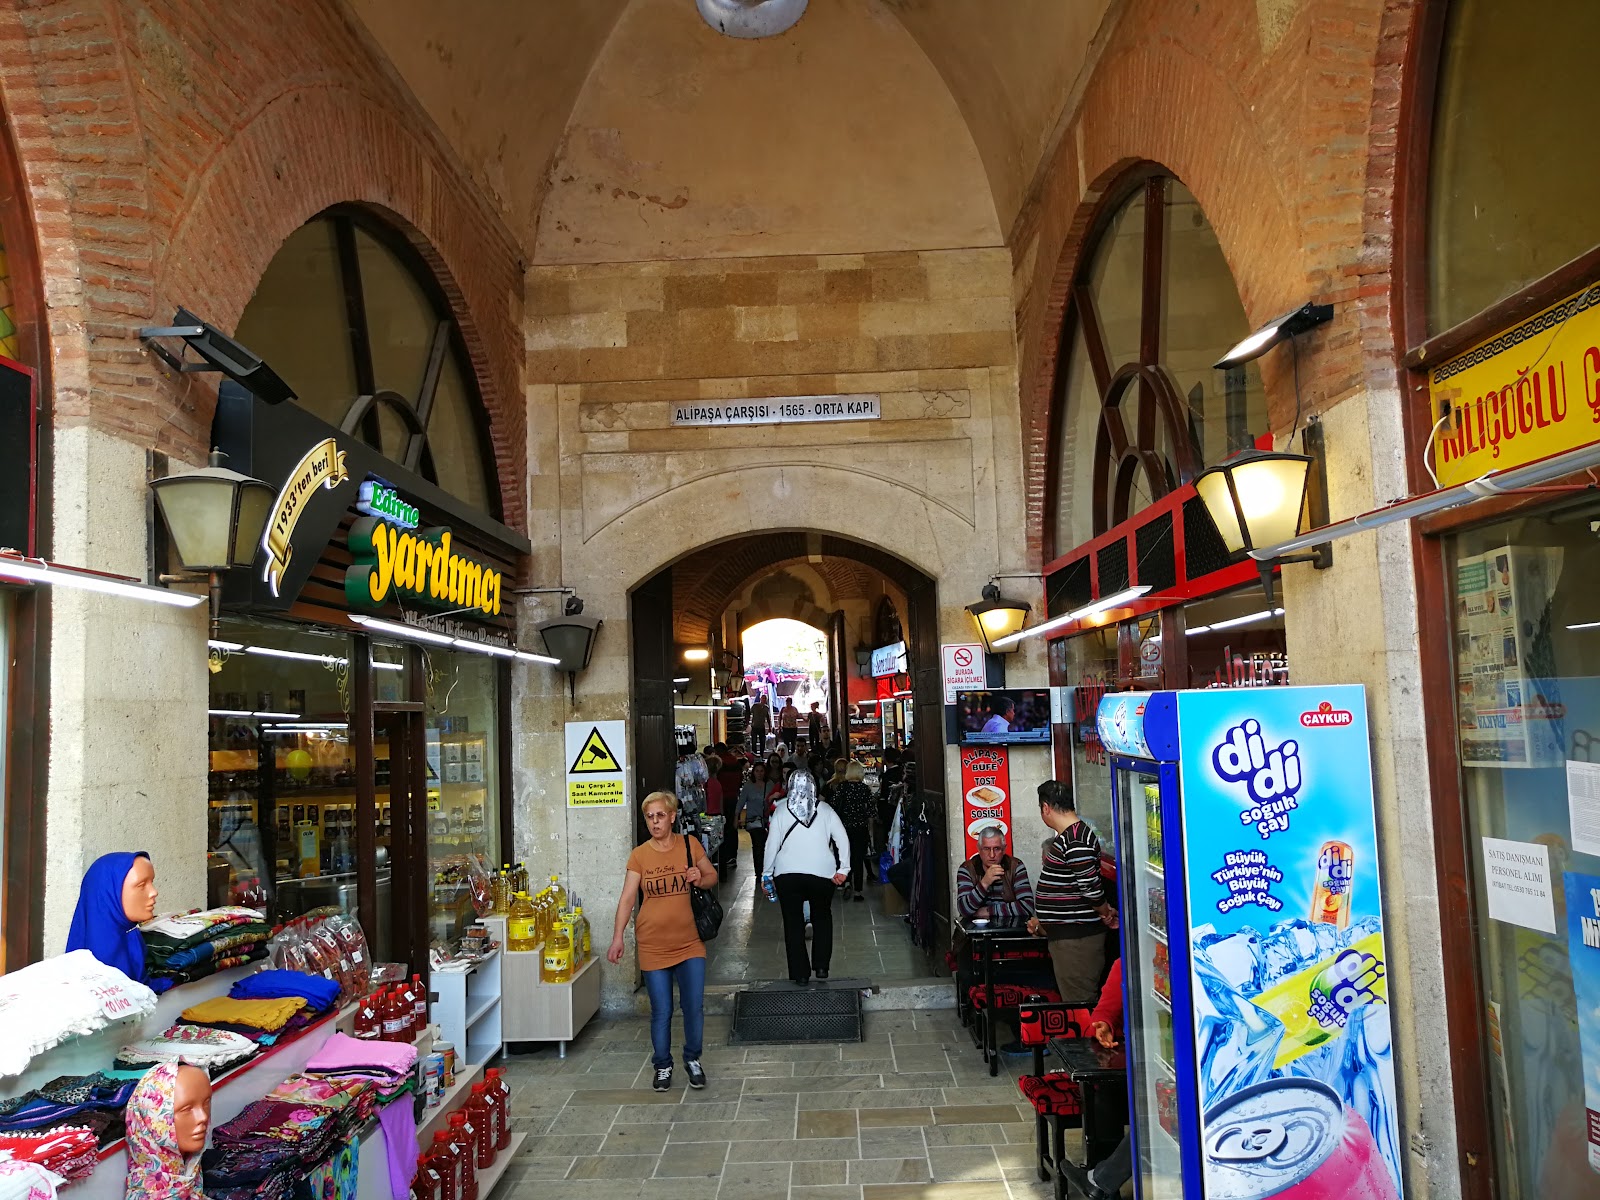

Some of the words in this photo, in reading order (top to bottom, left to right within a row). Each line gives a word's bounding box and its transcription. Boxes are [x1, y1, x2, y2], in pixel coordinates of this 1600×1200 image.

[676, 405, 722, 423] ALİPAŞA
[725, 405, 769, 422] ÇARŞISI
[779, 403, 805, 417] 1565
[815, 402, 844, 415] ORTA
[847, 401, 873, 414] KAPI
[276, 473, 312, 536] 1933'ten
[311, 452, 329, 478] beri
[370, 480, 419, 527] Edirne
[369, 522, 501, 616] yardımcı
[947, 676, 964, 684] SİGARA
[964, 675, 983, 684] İÇİLMEZ
[955, 668, 974, 676] BURADA
[1302, 712, 1351, 727] ÇAYKUR
[963, 748, 1004, 768] ALİPAŞA
[972, 761, 998, 772] BÜFE
[974, 776, 996, 787] TOST
[971, 806, 1003, 819] SOSİSLİ
[1240, 796, 1298, 825] soğuk
[1257, 813, 1289, 839] çay
[1226, 851, 1266, 866] Büyük
[1488, 849, 1506, 862] SATIŞ
[1506, 852, 1544, 867] DANIŞMANI
[1213, 865, 1282, 883] Türkiye'nin
[1491, 865, 1523, 880] PERSONEL
[1229, 877, 1269, 892] Büyük
[1218, 890, 1256, 912] Soğuk
[1256, 891, 1282, 911] Çayı
[98, 984, 123, 997] tane
[105, 1000, 118, 1014] 10
[116, 997, 132, 1011] lira
